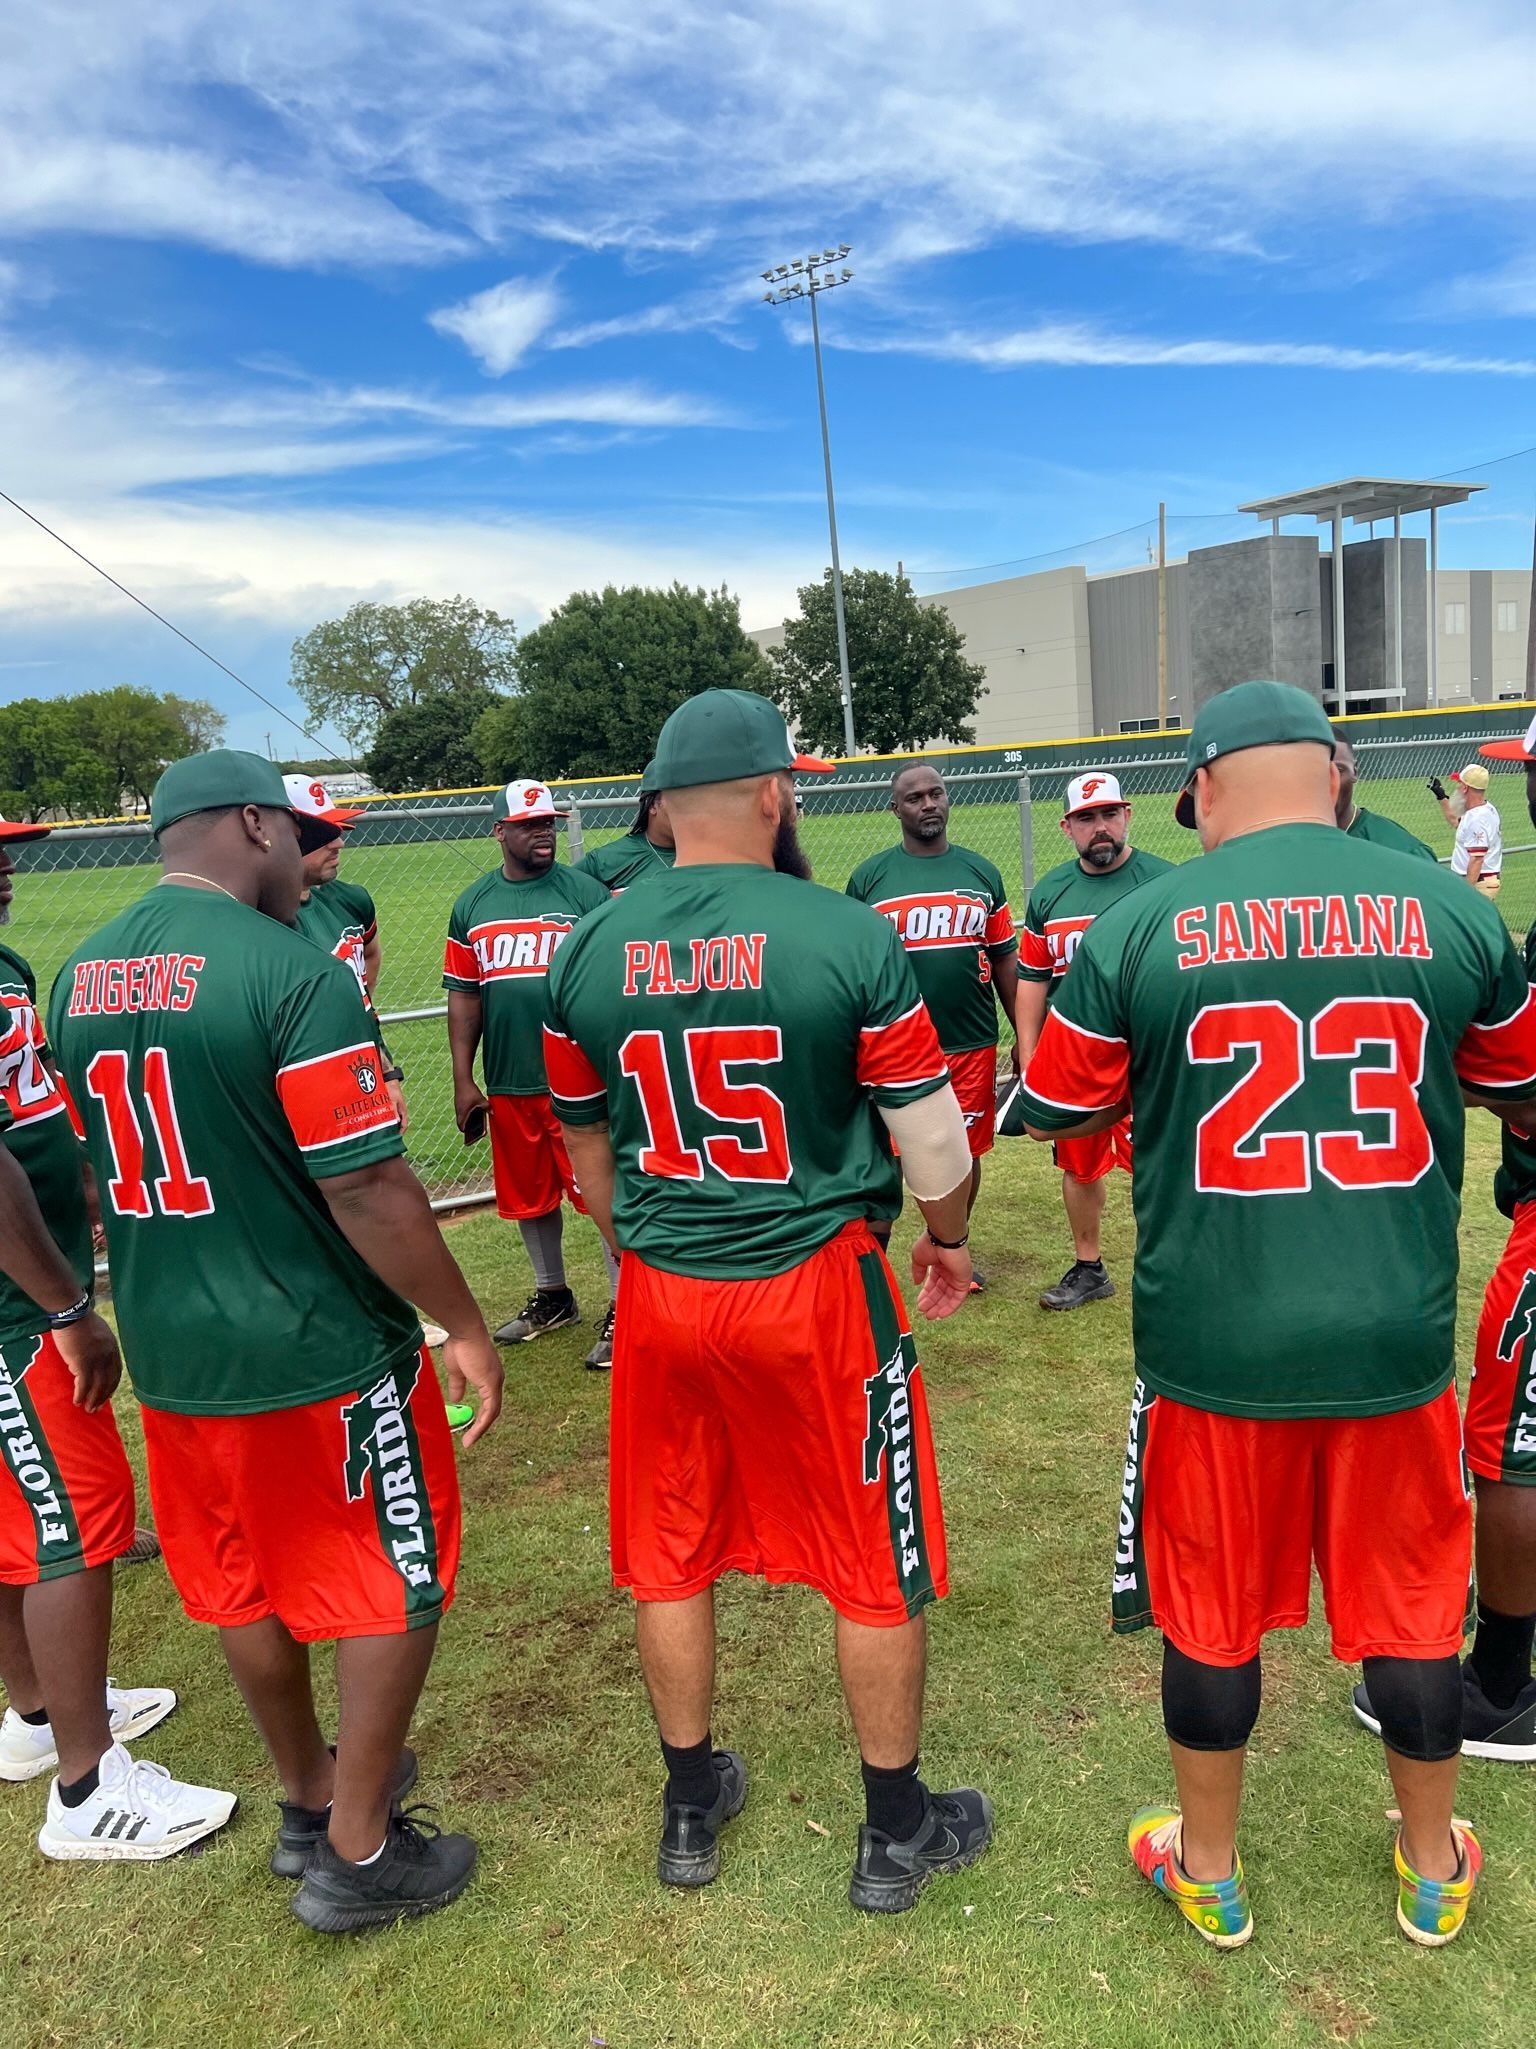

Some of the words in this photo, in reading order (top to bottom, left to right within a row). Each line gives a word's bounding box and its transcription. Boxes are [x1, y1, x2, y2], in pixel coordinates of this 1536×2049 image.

[1004, 751, 1023, 763] 305
[1082, 779, 1106, 800] F
[524, 787, 545, 807] F
[623, 933, 767, 996] PAJON
[1173, 894, 1433, 971] SANTANA
[69, 953, 206, 1017] HIGGINS
[334, 1097, 370, 1120] ELITE
[618, 1025, 793, 1184] 15
[1186, 996, 1435, 1195] 23
[87, 1046, 215, 1218] 11
[370, 1375, 432, 1587] FLORIDA
[887, 1351, 920, 1577] FLORIDA
